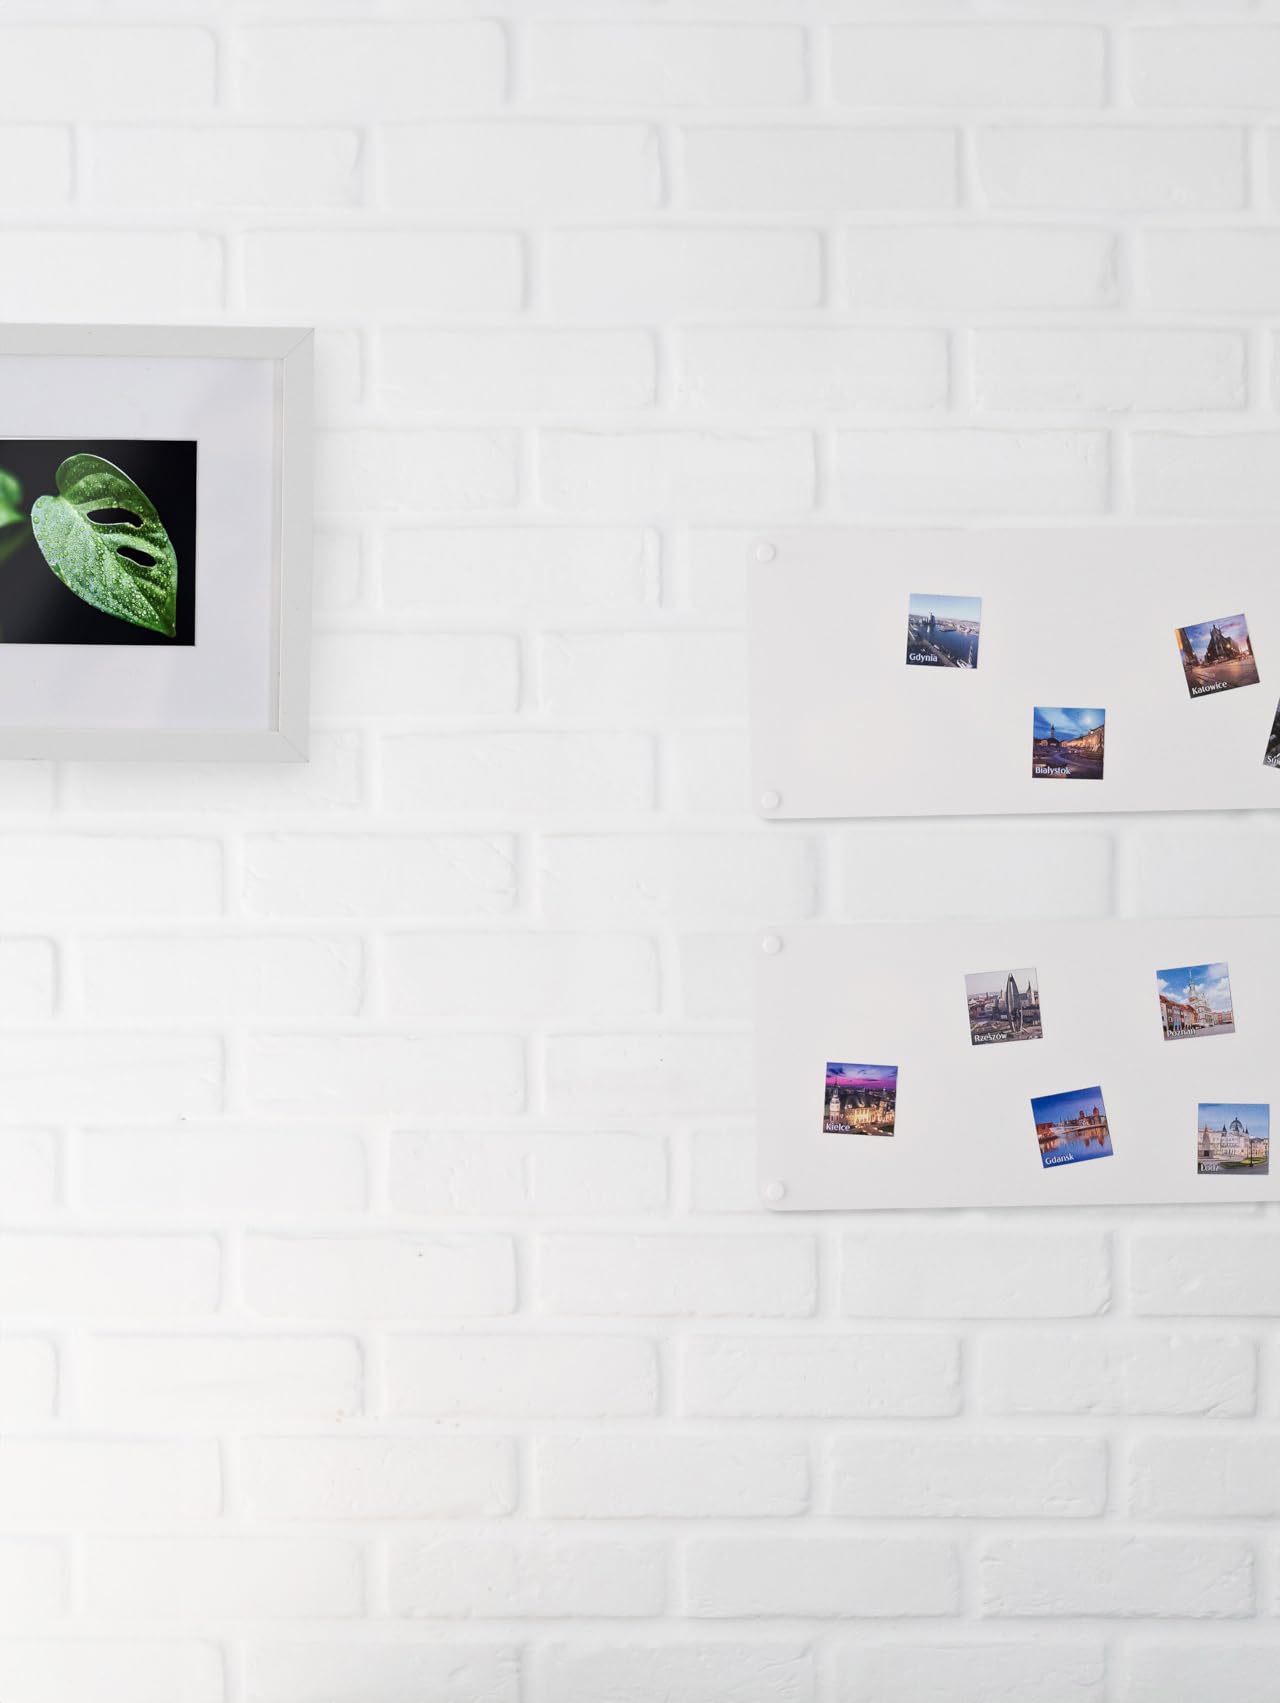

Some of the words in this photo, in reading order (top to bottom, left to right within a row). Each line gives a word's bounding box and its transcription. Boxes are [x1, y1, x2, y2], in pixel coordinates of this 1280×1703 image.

[909, 652, 938, 663] Gdynia
[1192, 681, 1228, 695] Katowice
[826, 1123, 851, 1131] Kielce
